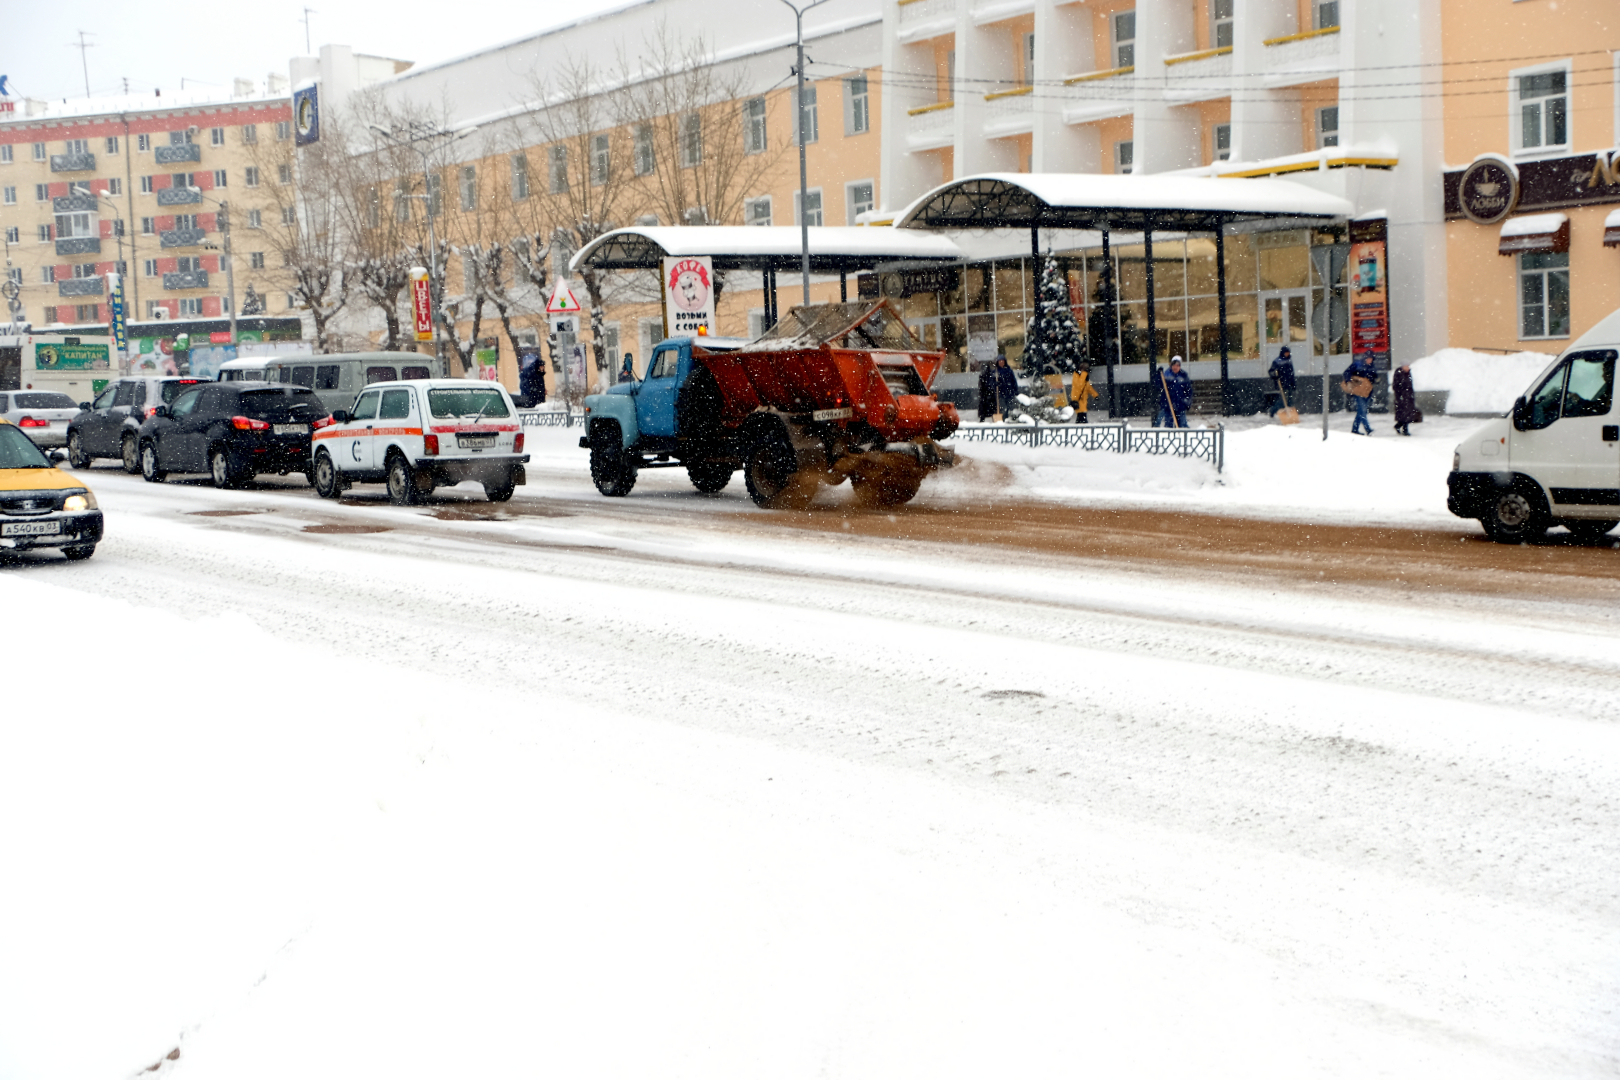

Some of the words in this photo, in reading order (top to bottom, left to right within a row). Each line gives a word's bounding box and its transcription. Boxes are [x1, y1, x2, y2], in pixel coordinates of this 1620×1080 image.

[1470, 196, 1505, 209] ЛОББИ
[676, 261, 702, 274] КОФЕ
[415, 281, 430, 331] ЦВЕТЫ
[676, 312, 707, 320] ВОЗЬМИ
[6, 524, 45, 534] А540КВ
